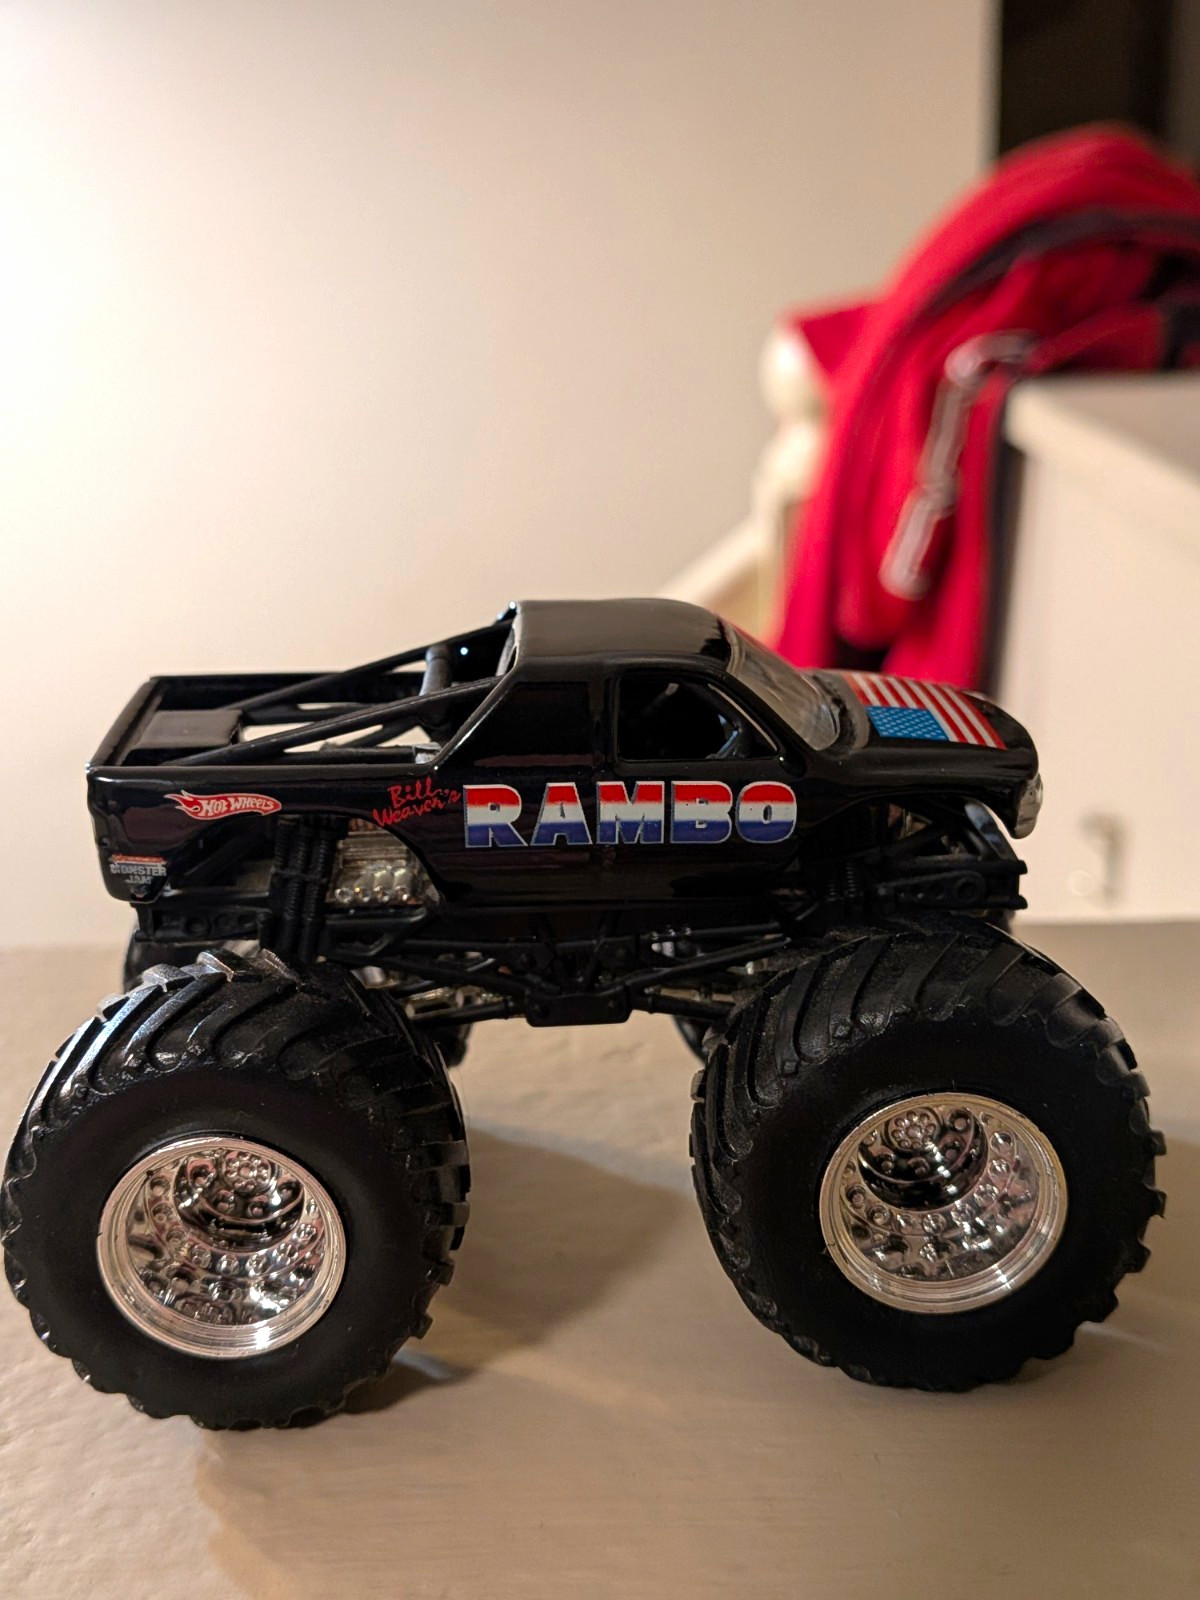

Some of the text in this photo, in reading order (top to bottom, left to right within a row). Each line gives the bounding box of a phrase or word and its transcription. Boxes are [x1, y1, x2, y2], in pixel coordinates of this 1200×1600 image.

[387, 776, 442, 808] Bill
[463, 780, 797, 848] RAMBO
[109, 863, 167, 877] MONSTER
